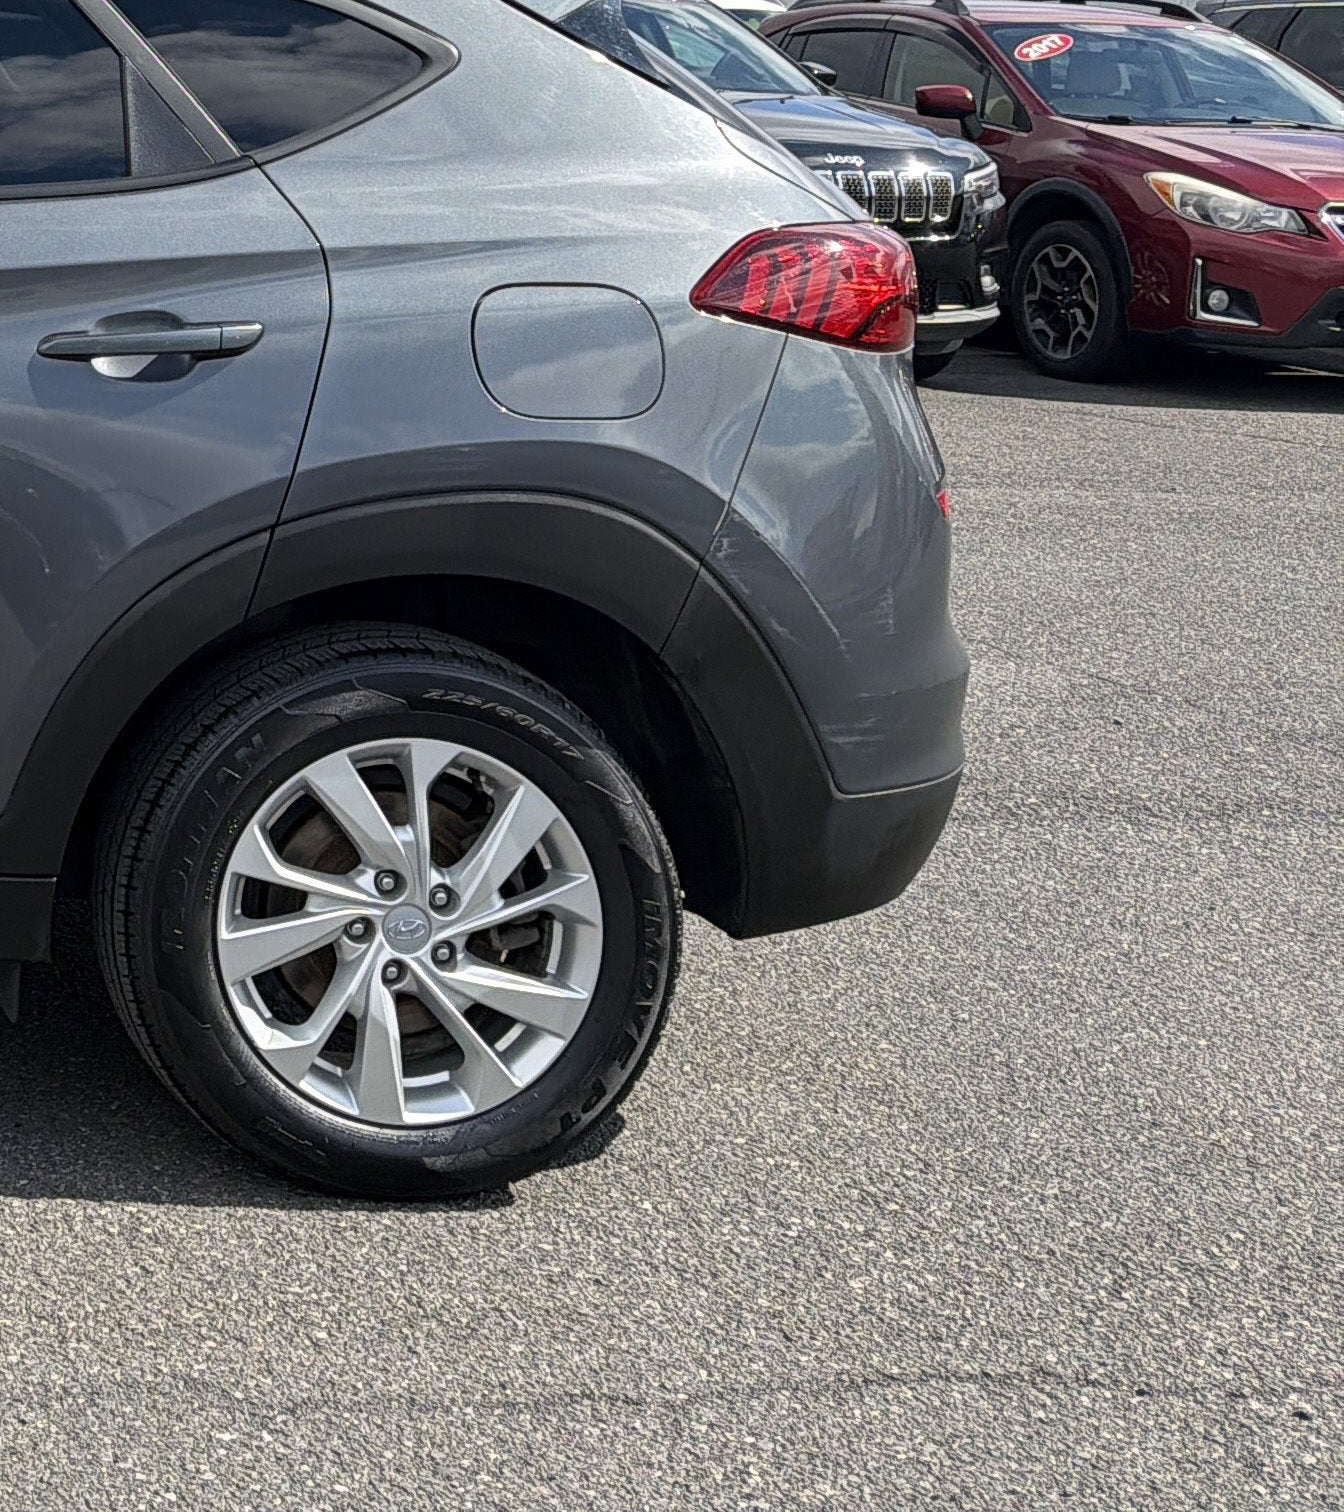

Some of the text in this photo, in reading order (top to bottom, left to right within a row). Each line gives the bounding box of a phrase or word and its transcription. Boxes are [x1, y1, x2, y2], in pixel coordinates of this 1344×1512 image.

[1021, 35, 1065, 59] 2017
[823, 152, 865, 168] Jeep
[421, 688, 585, 761] 225/60R17
